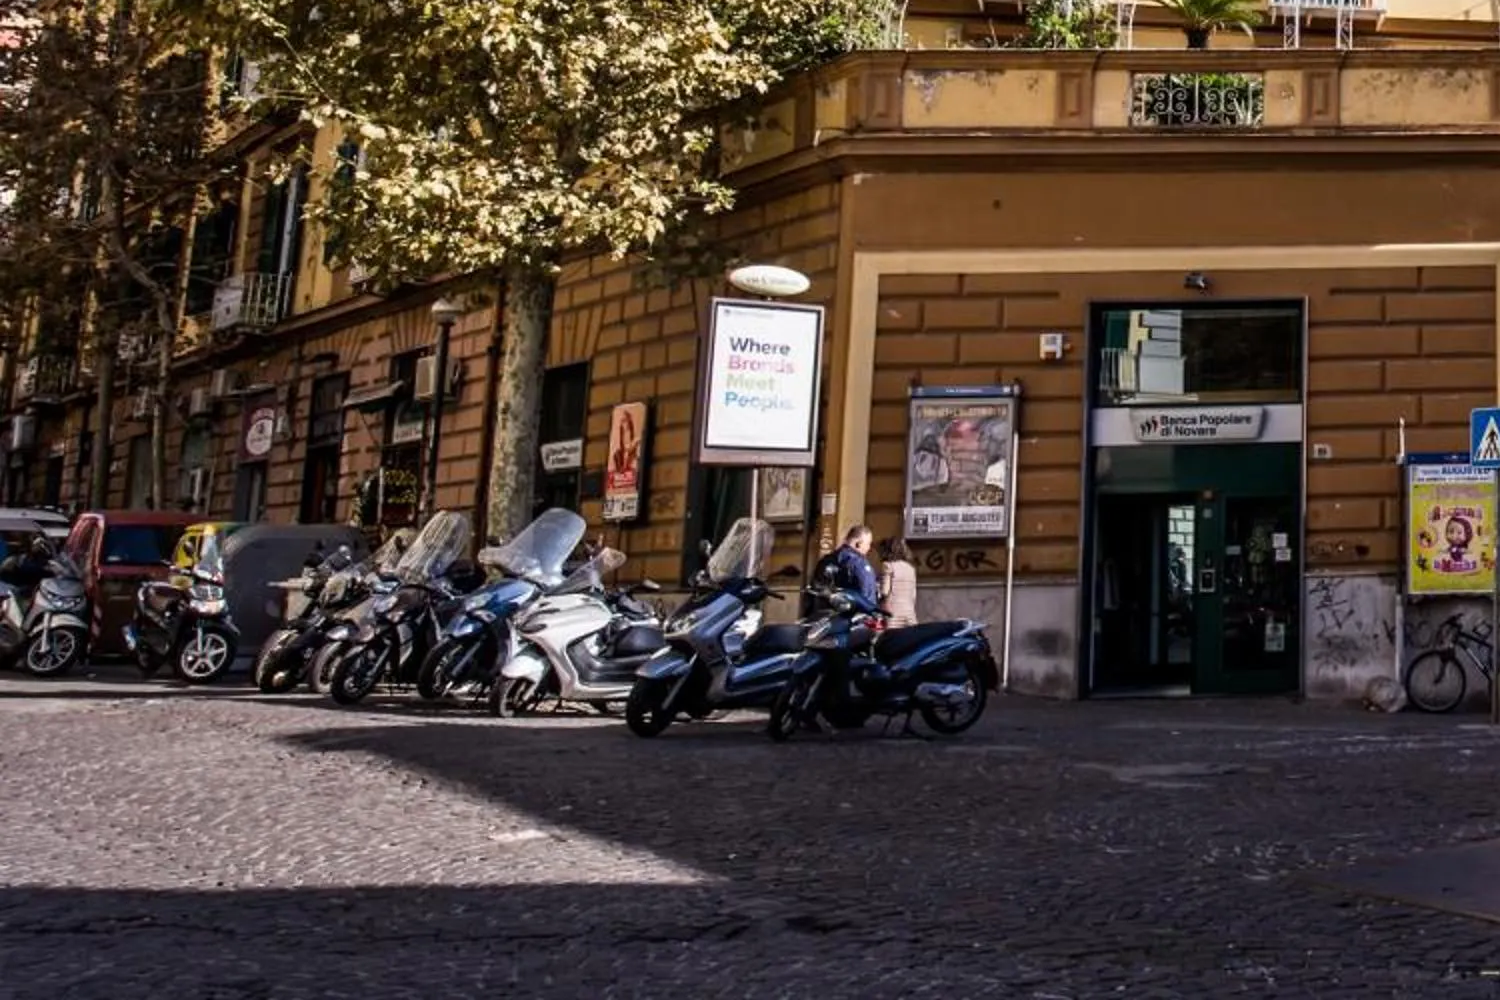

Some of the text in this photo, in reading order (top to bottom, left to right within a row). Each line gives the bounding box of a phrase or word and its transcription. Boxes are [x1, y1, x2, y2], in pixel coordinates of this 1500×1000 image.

[730, 336, 791, 356] Where
[726, 374, 775, 391] Meet
[1160, 414, 1252, 427] Banca Popolare
[1174, 426, 1217, 437] Novara
